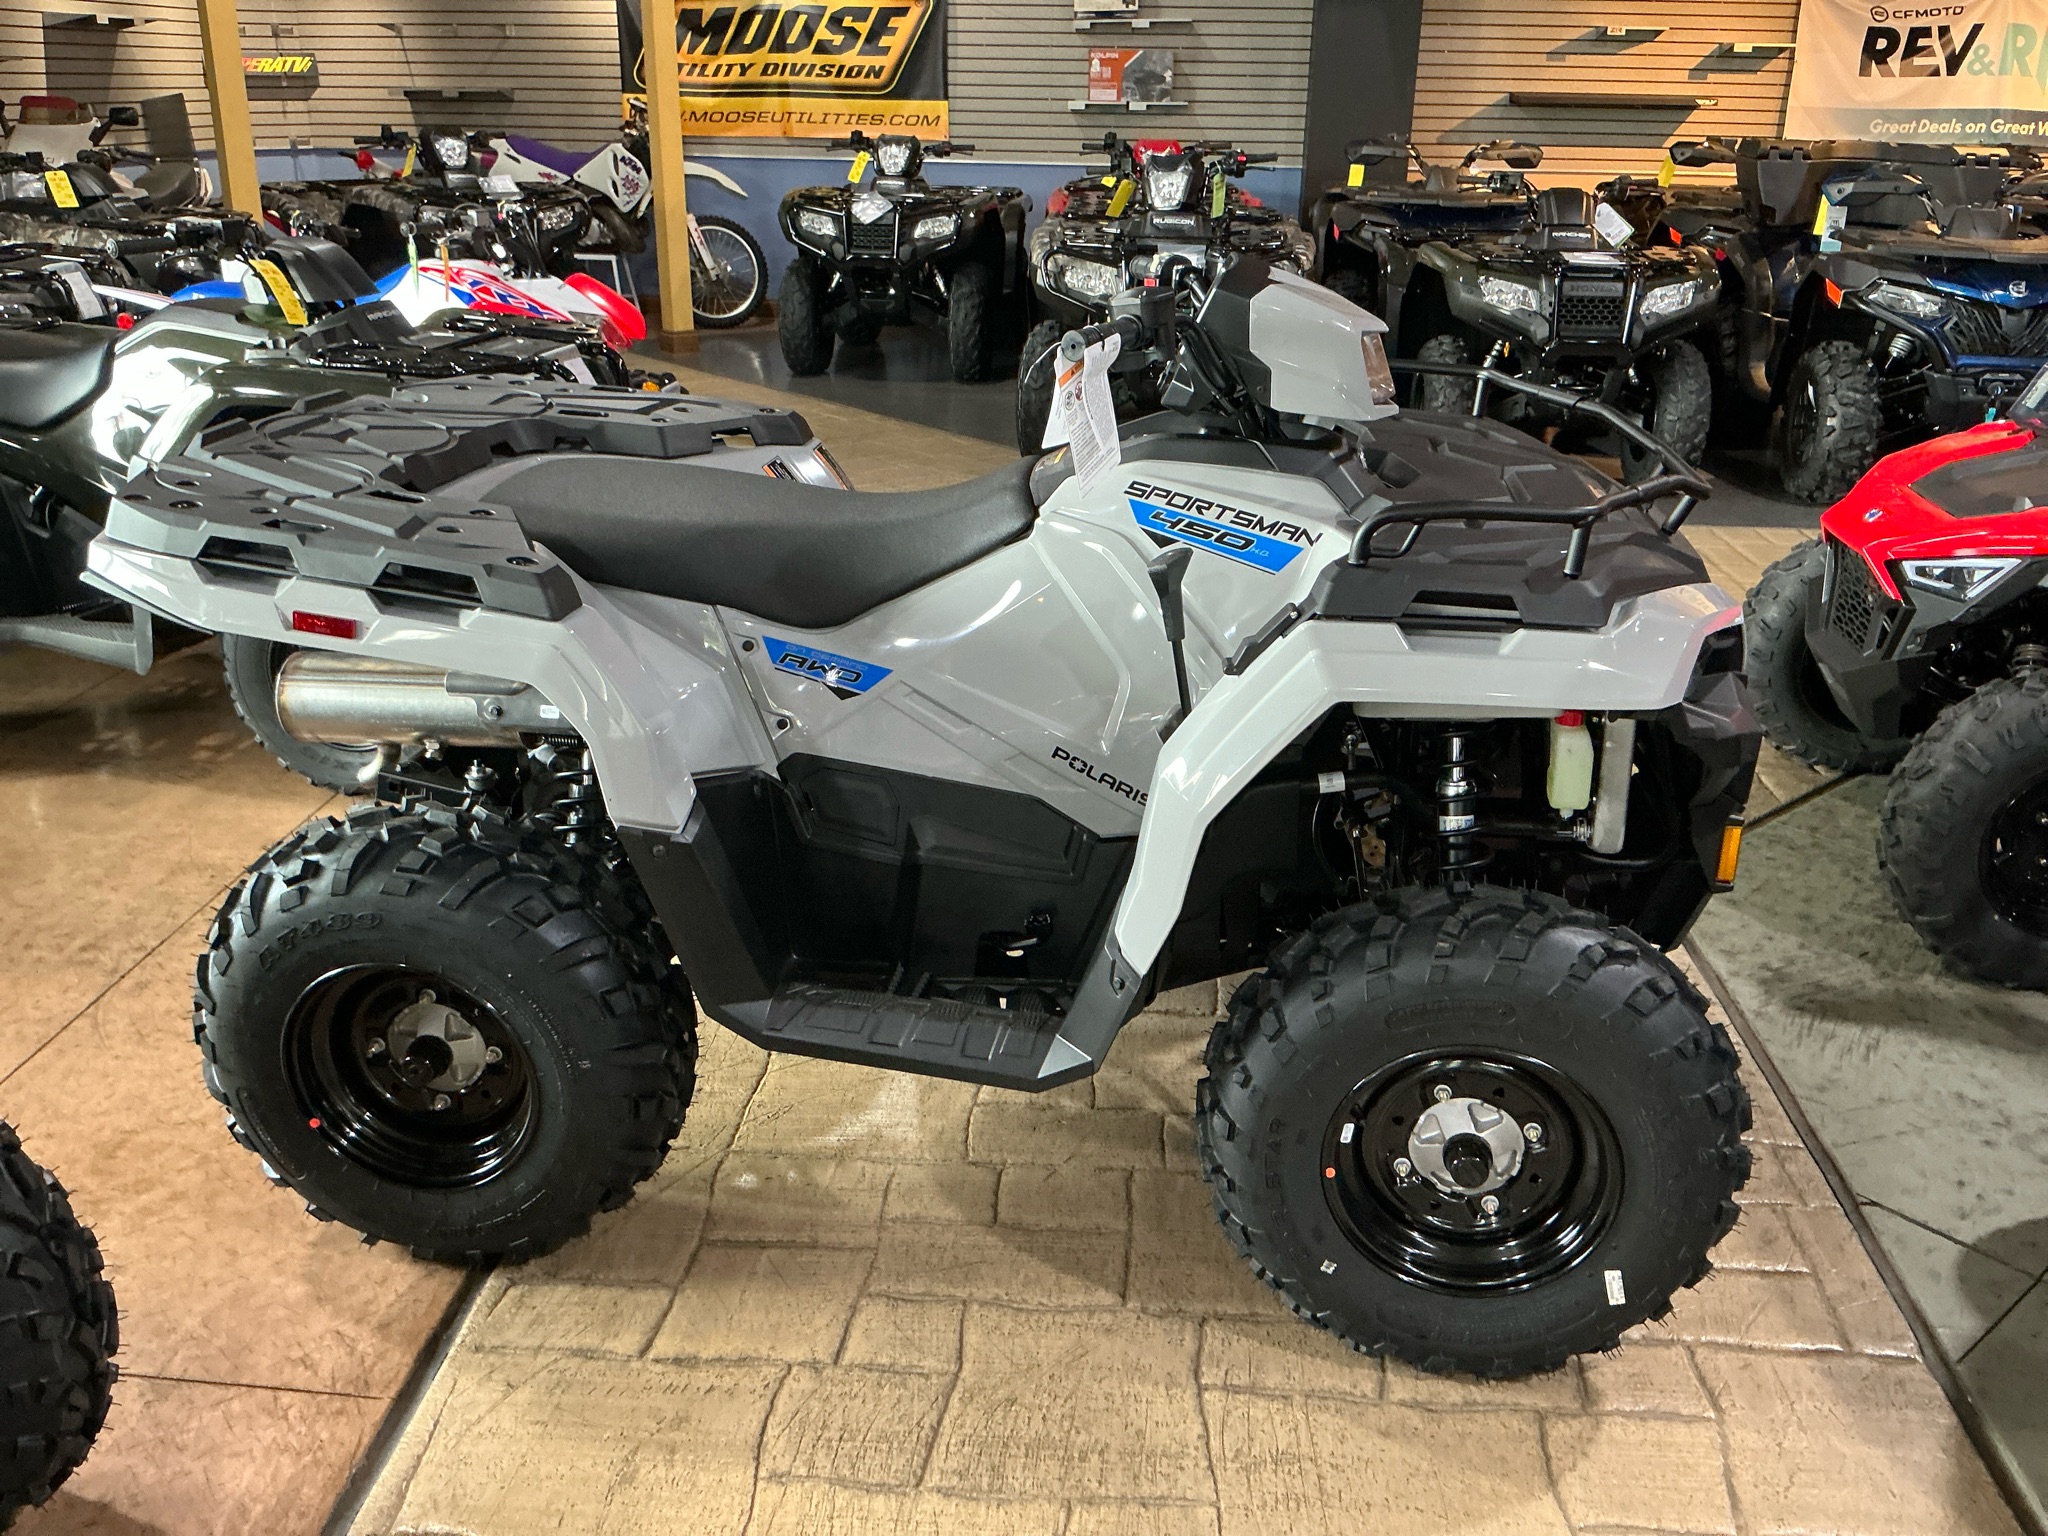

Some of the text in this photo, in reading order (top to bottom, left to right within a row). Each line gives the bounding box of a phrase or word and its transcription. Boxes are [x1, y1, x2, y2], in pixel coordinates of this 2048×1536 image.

[1893, 6, 1964, 19] CFMOTO
[676, 6, 911, 57] MOOSE
[676, 62, 886, 80] TILITY DIVISION
[1869, 118, 1916, 134] Great
[1917, 118, 1962, 134] Deals
[1965, 121, 1987, 133] on
[1990, 119, 2036, 135] Great
[1153, 217, 1195, 226] RUBICON
[1123, 480, 1324, 547] SPORTSMAN
[1149, 510, 1257, 552] 450
[778, 652, 863, 684] AWD
[1051, 745, 1149, 807] POLARIS
